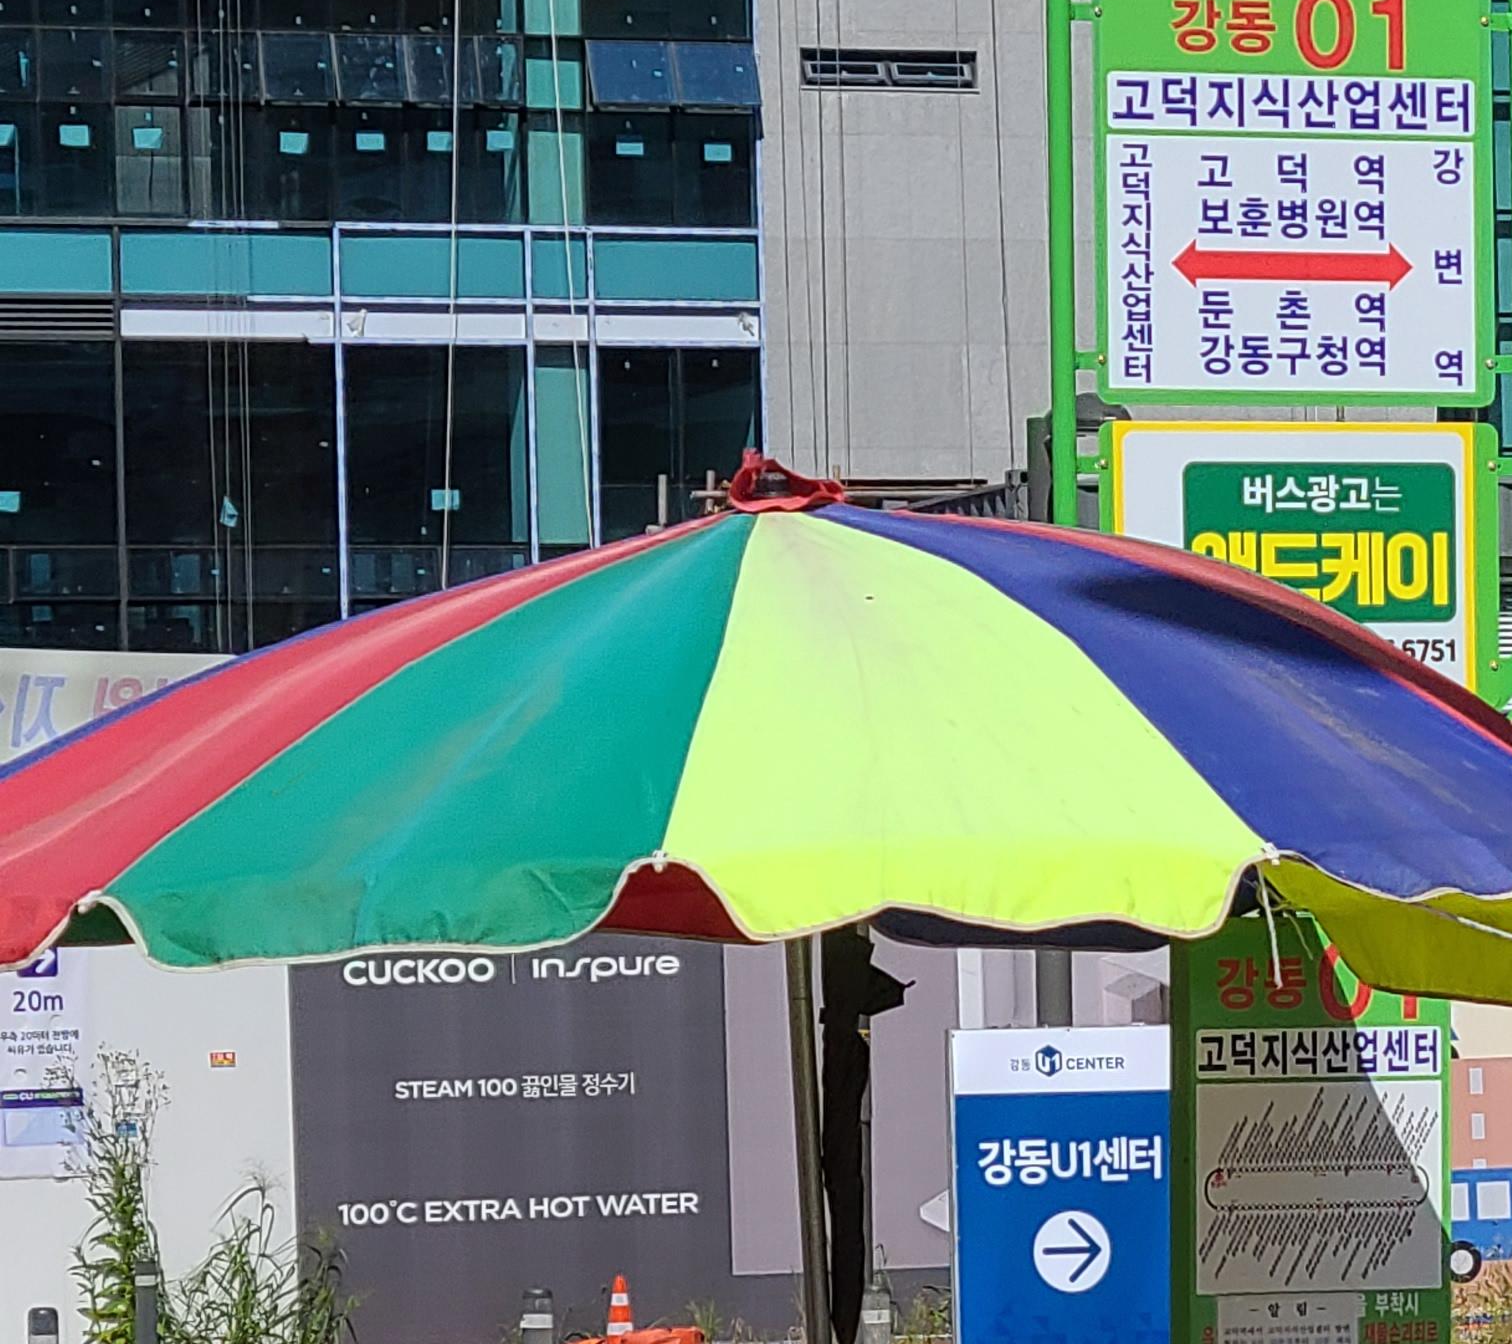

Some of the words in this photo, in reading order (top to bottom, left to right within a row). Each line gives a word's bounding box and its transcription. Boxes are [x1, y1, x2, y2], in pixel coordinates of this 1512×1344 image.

[1112, 76, 1471, 132] 고덕지식산업센터
[1198, 197, 1386, 241] 보훈병원역
[1119, 143, 1154, 384] 고덕지식산업센터
[1199, 335, 1387, 377] 강동구청역
[1242, 473, 1403, 514] 버스광고는
[343, 957, 495, 986] CUCKOO
[1217, 956, 1307, 1010] 강동
[12, 990, 64, 1013] 20m
[1065, 1056, 1125, 1071] CENTER
[1198, 1030, 1438, 1077] 고덕지식산업센터
[394, 1079, 473, 1099] STEAM
[477, 1078, 518, 1098] 100
[521, 1074, 578, 1098] 끓인물
[582, 1071, 636, 1097] 정수기
[977, 1136, 1163, 1186] 강동U1센터
[424, 1198, 522, 1223] EXTRA
[529, 1195, 591, 1219] HOT
[596, 1192, 700, 1216] WATER
[1374, 1291, 1419, 1318] 부착시
